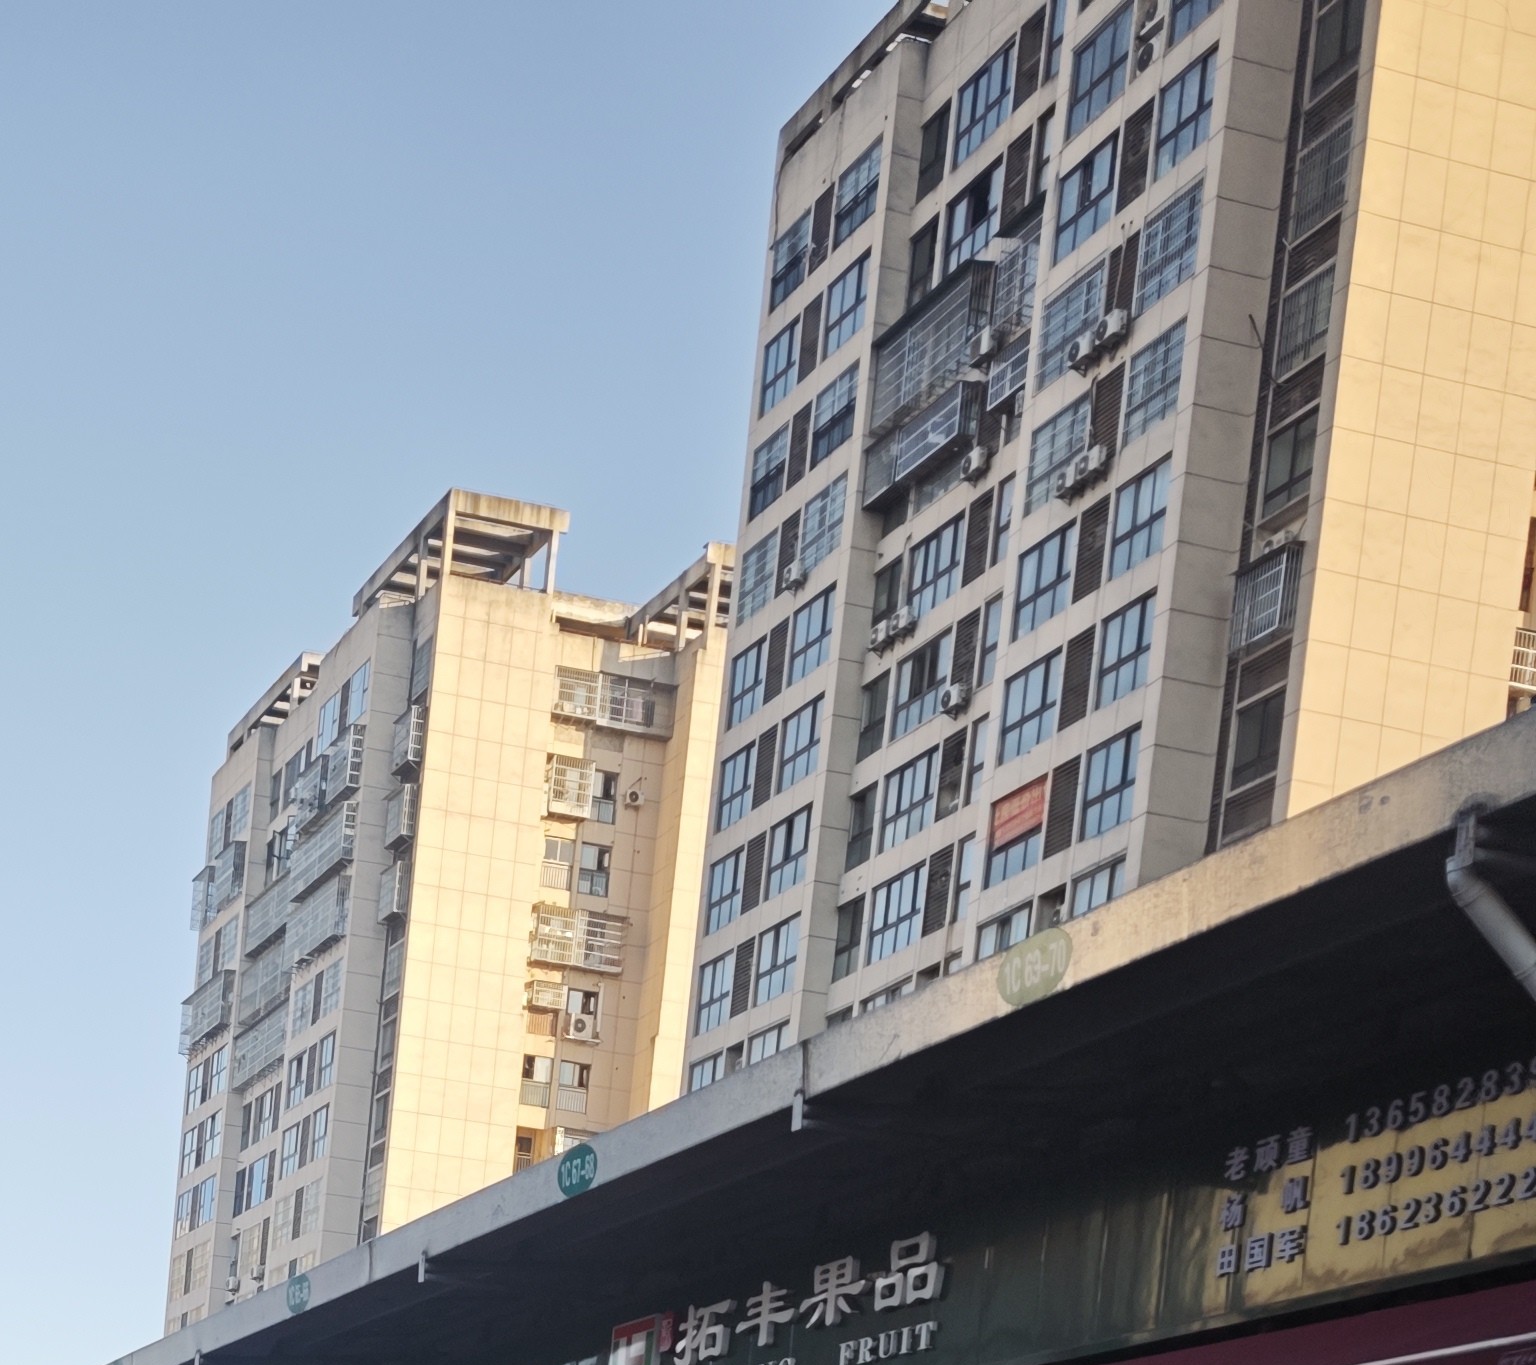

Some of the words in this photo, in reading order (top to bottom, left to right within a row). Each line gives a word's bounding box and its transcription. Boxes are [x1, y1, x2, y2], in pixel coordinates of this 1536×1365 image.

[1224, 1126, 1314, 1181] 老顽童
[1345, 1055, 1536, 1143] 13658283
[1217, 1225, 1307, 1277] 田国军
